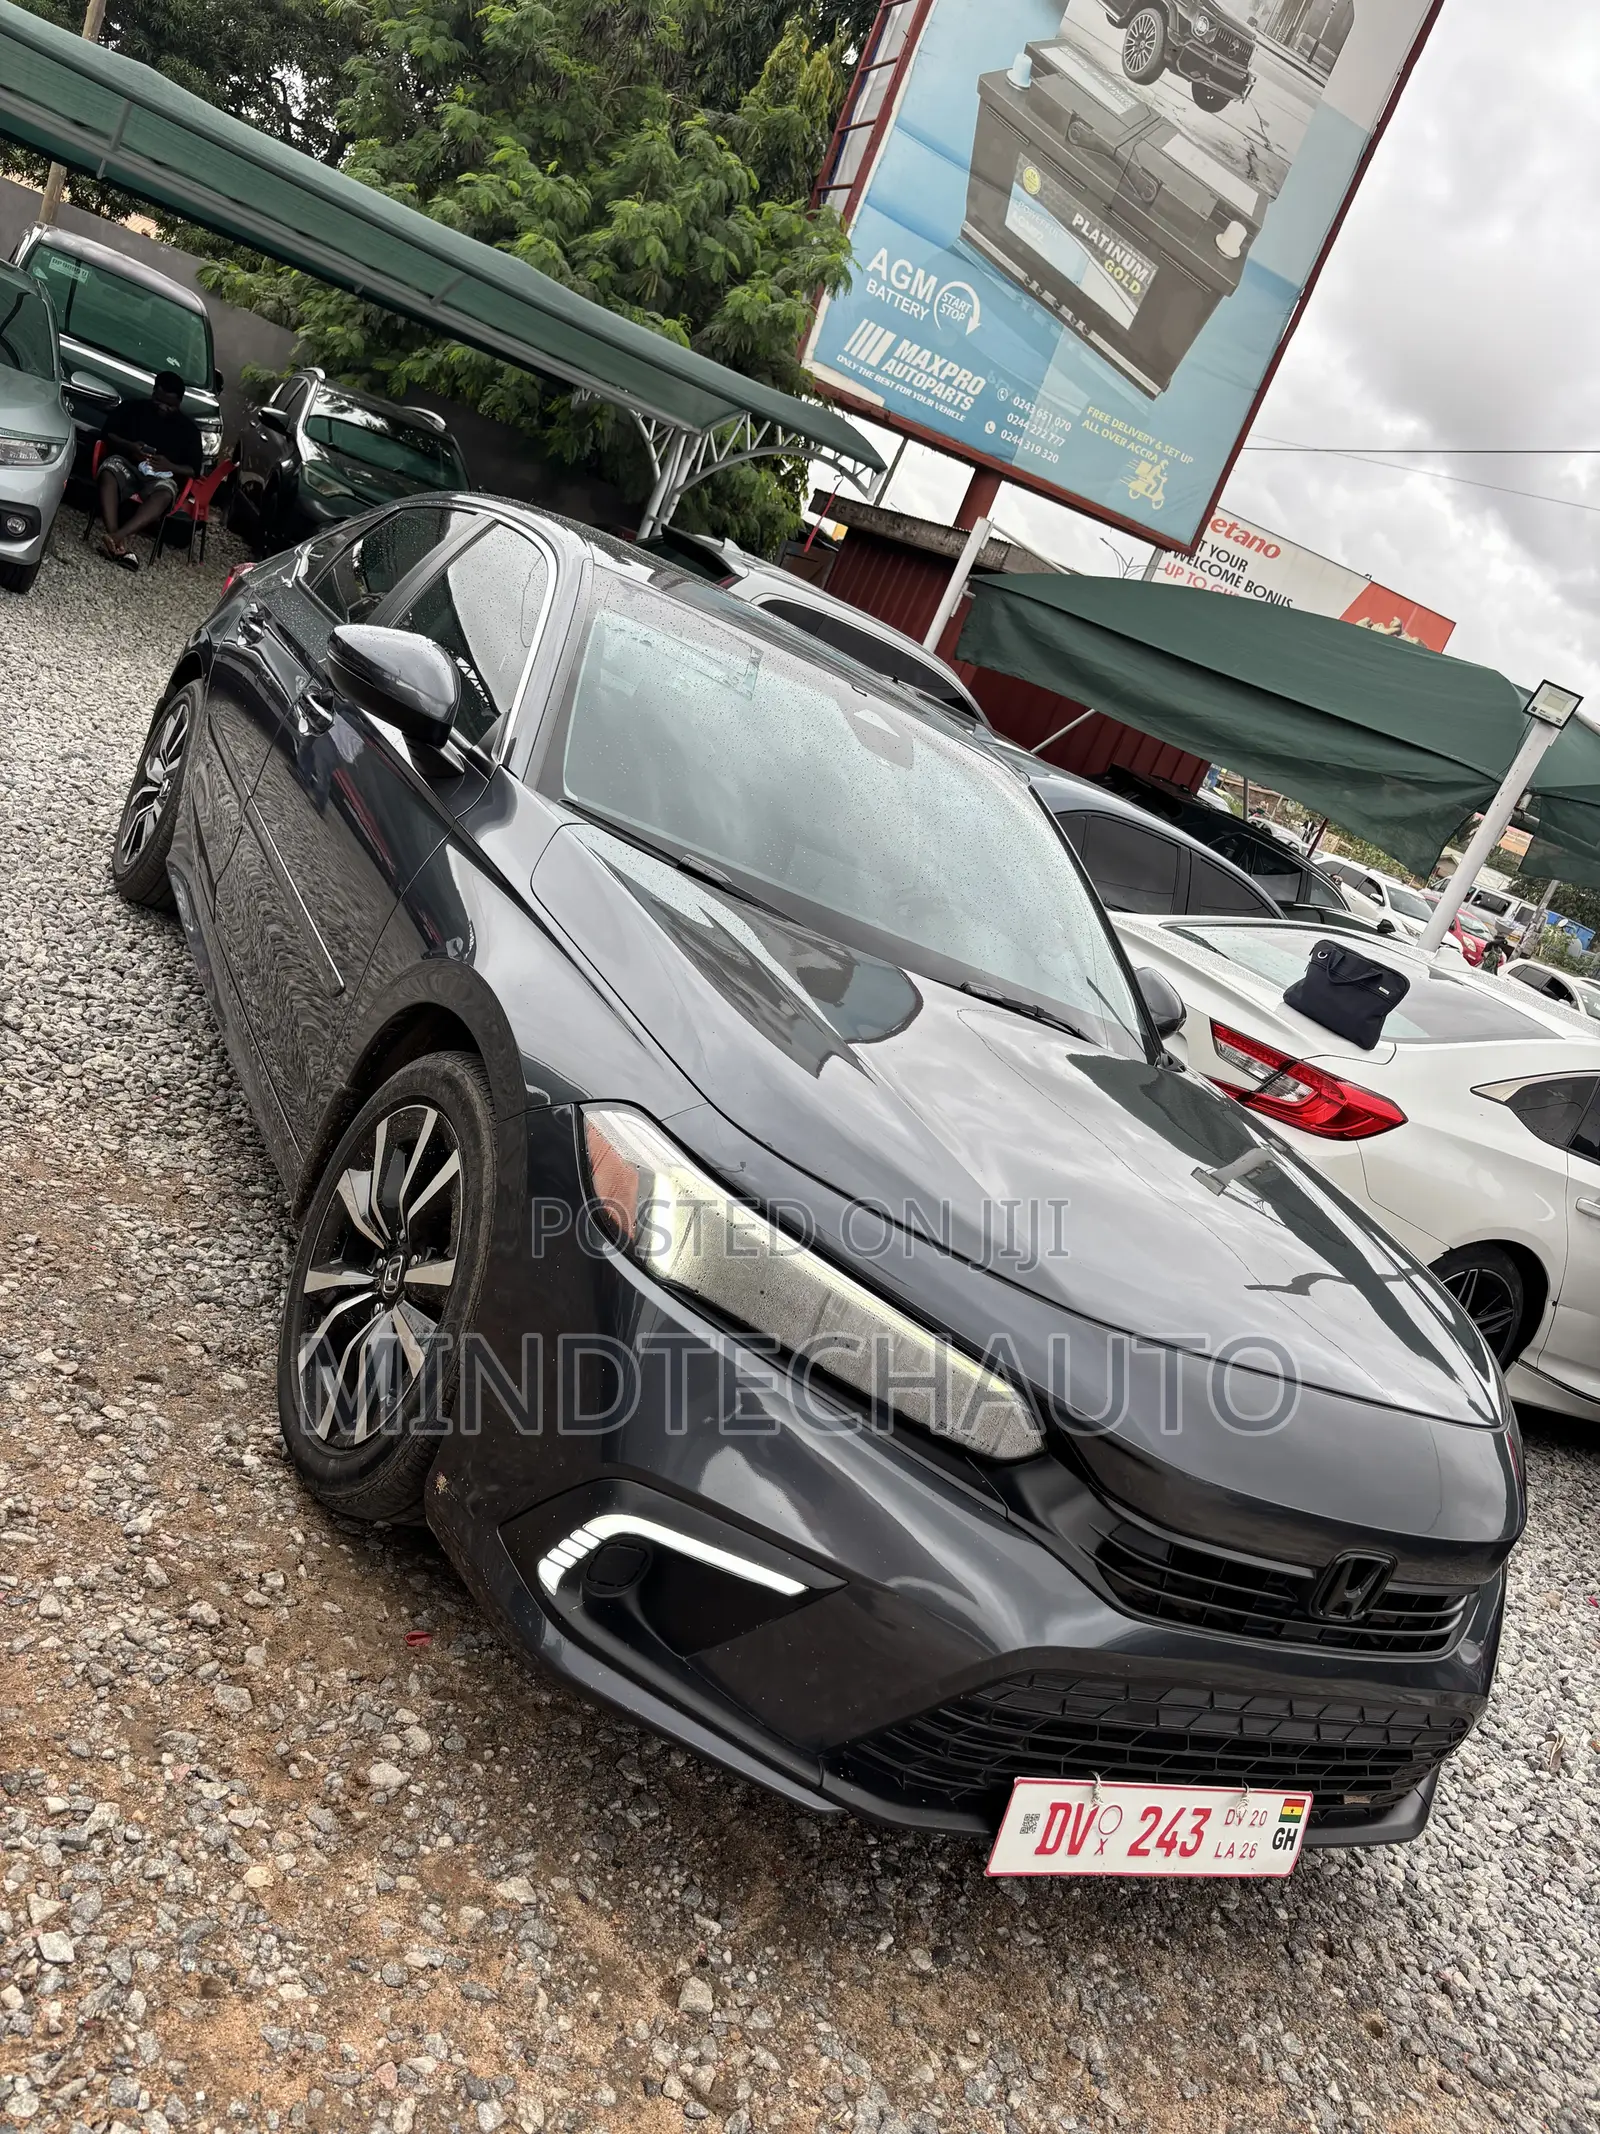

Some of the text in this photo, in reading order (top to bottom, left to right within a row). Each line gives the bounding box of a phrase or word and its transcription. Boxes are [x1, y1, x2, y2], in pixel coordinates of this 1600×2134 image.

[1071, 213, 1149, 282] PLATINUM
[866, 247, 938, 303] AGM
[1104, 259, 1141, 294] GOLD
[866, 278, 929, 321] BATTERY
[939, 304, 966, 322] STOP
[941, 292, 972, 314] START
[881, 358, 975, 411] AUTOPARTS
[893, 338, 986, 396] MAXPRO
[836, 354, 966, 423] ONLY THE BEST FOR YOUR VEHICLE
[1007, 412, 1066, 447] 0244 272 777
[1013, 396, 1072, 432] 0243 651 070
[1001, 429, 1059, 464] 0244 319 320
[1081, 419, 1158, 464] ALL OVER ACCRA
[1087, 406, 1194, 465] FREE DELIVERY & SET UP
[1210, 518, 1281, 559] etano
[1164, 561, 1185, 579] UP
[1186, 571, 1207, 589] TO
[1209, 544, 1249, 573] YOUR
[1173, 551, 1293, 608] WELCOME BONUS
[1034, 1801, 1100, 1856] DV
[1127, 1806, 1213, 1858] 243
[1224, 1808, 1268, 1827] DV 20
[1214, 1841, 1259, 1859] LA 26
[1271, 1827, 1299, 1851] GH
